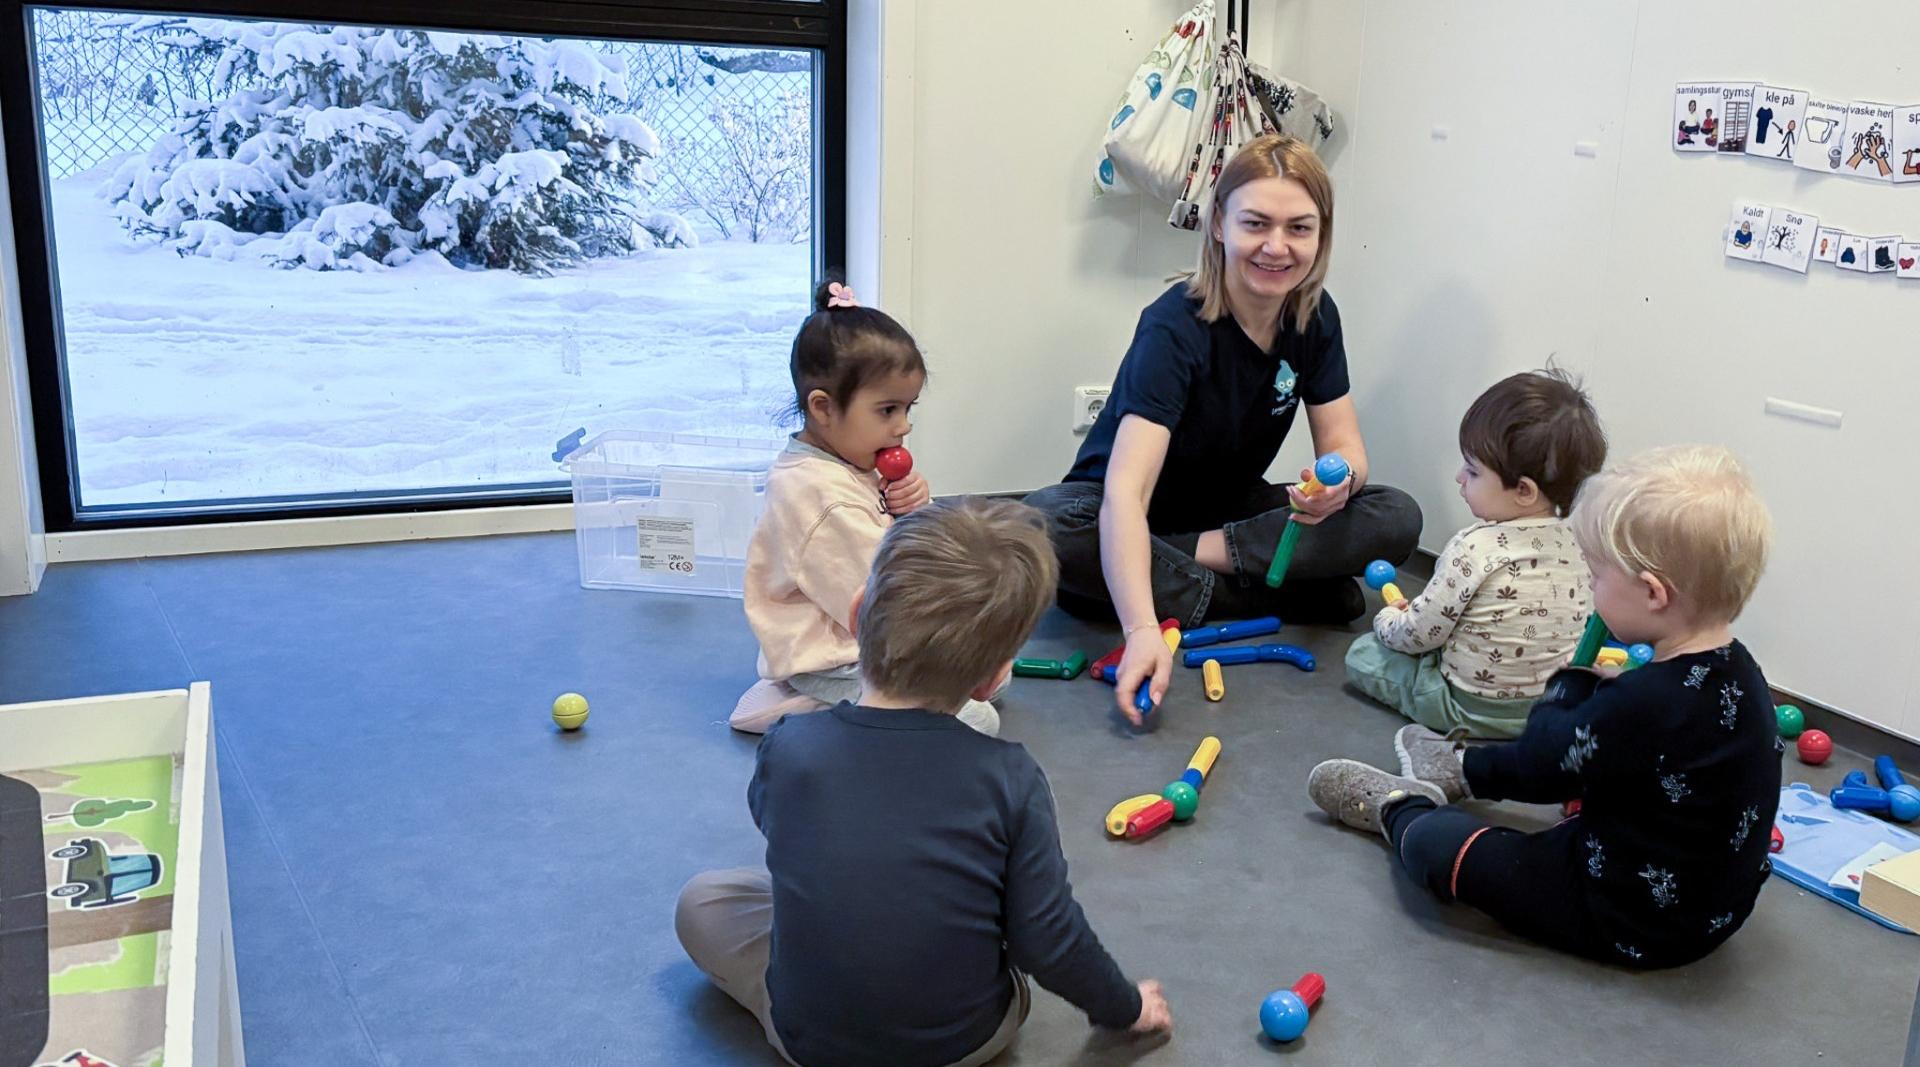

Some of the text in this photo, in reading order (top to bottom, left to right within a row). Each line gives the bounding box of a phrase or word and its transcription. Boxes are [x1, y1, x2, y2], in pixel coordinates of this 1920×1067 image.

[1765, 91, 1795, 107] kle på
[1850, 106, 1876, 117] vaske
[1743, 206, 1764, 218] Kaldt
[1785, 214, 1803, 225] Snø
